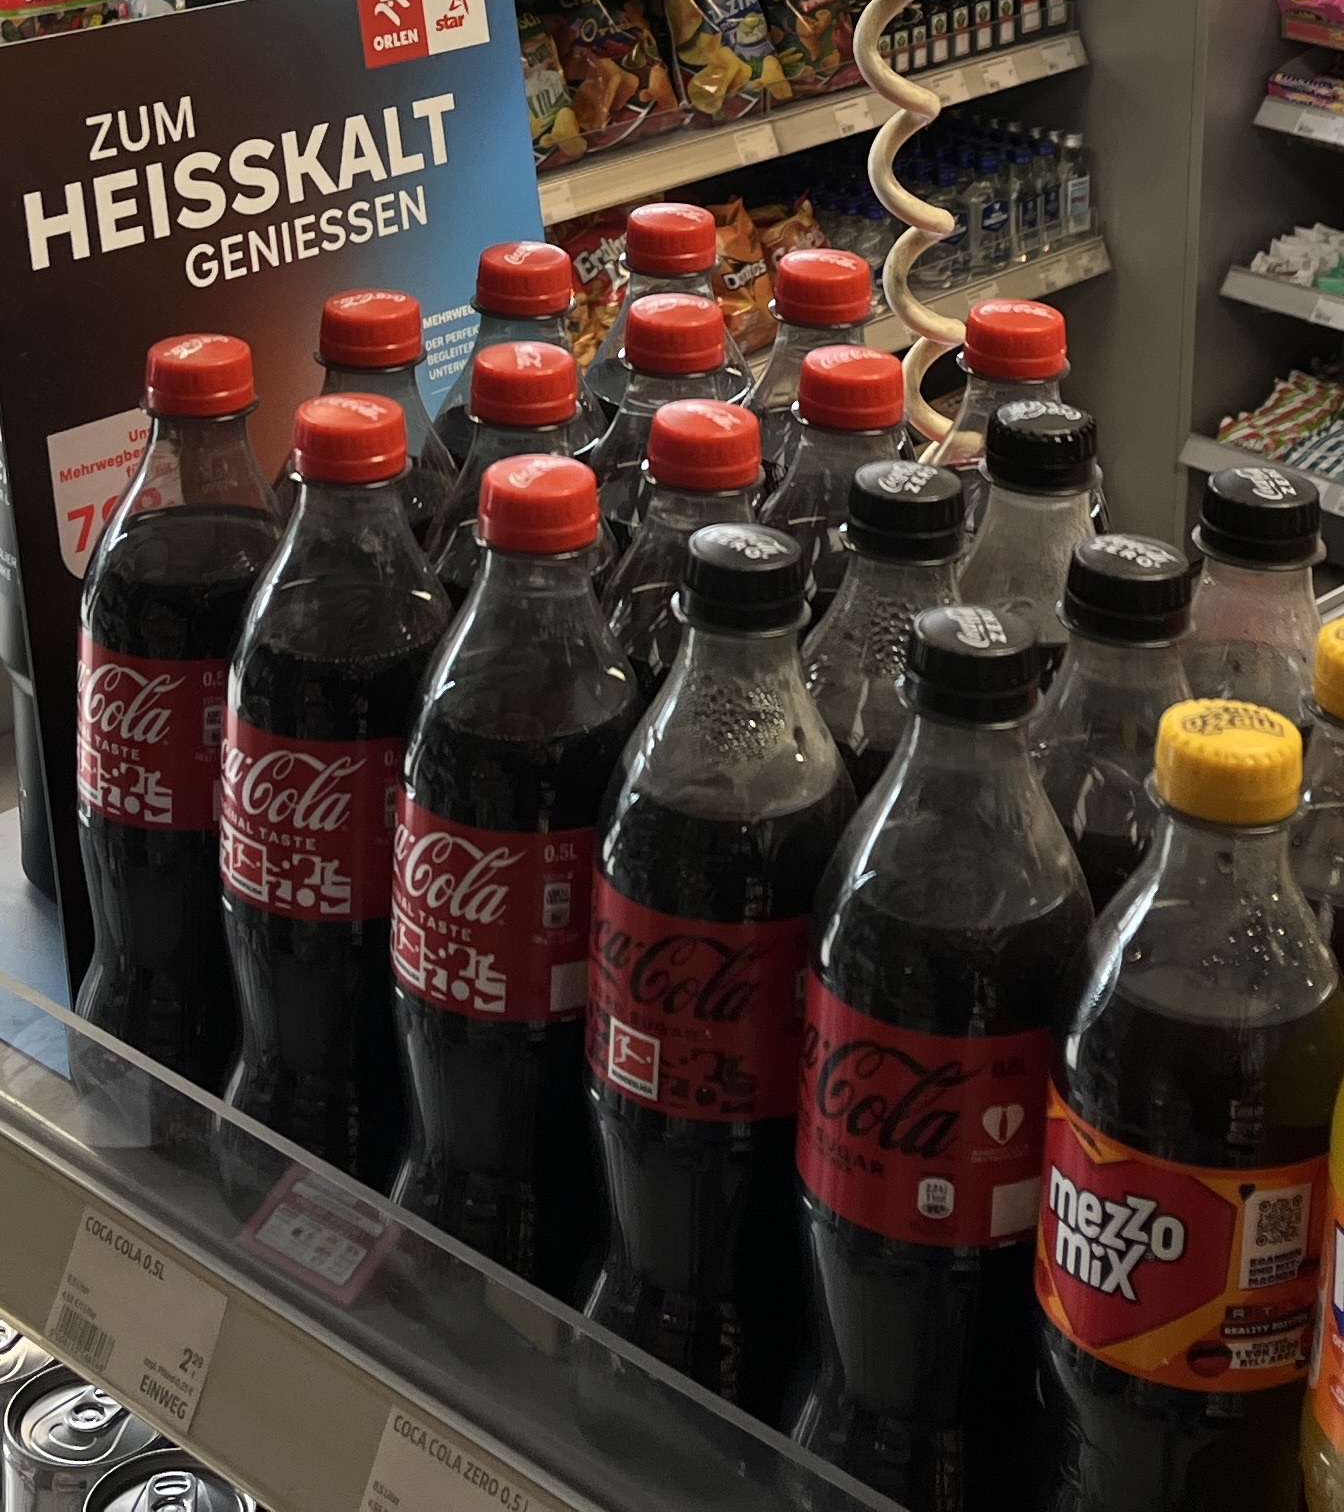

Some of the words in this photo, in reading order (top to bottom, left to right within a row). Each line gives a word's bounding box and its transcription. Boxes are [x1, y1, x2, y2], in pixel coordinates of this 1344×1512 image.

[373, 28, 420, 52] ORLEN
[435, 12, 467, 33] star
[85, 95, 196, 162] ZUM
[22, 92, 457, 273] HEISSKALT
[184, 184, 429, 289] GENIESSEN
[95, 738, 141, 761] TASTE
[259, 826, 317, 852] TASTE
[413, 913, 473, 944] TASTE
[1047, 1165, 1186, 1262] mezzo
[85, 1215, 114, 1246] COCA
[114, 1234, 142, 1262] COLA
[143, 1254, 166, 1281] 0,5L
[139, 1374, 189, 1421] EINWEG
[393, 1414, 428, 1452] COCA
[428, 1438, 463, 1475] COLA
[463, 1460, 500, 1498] ZERO
